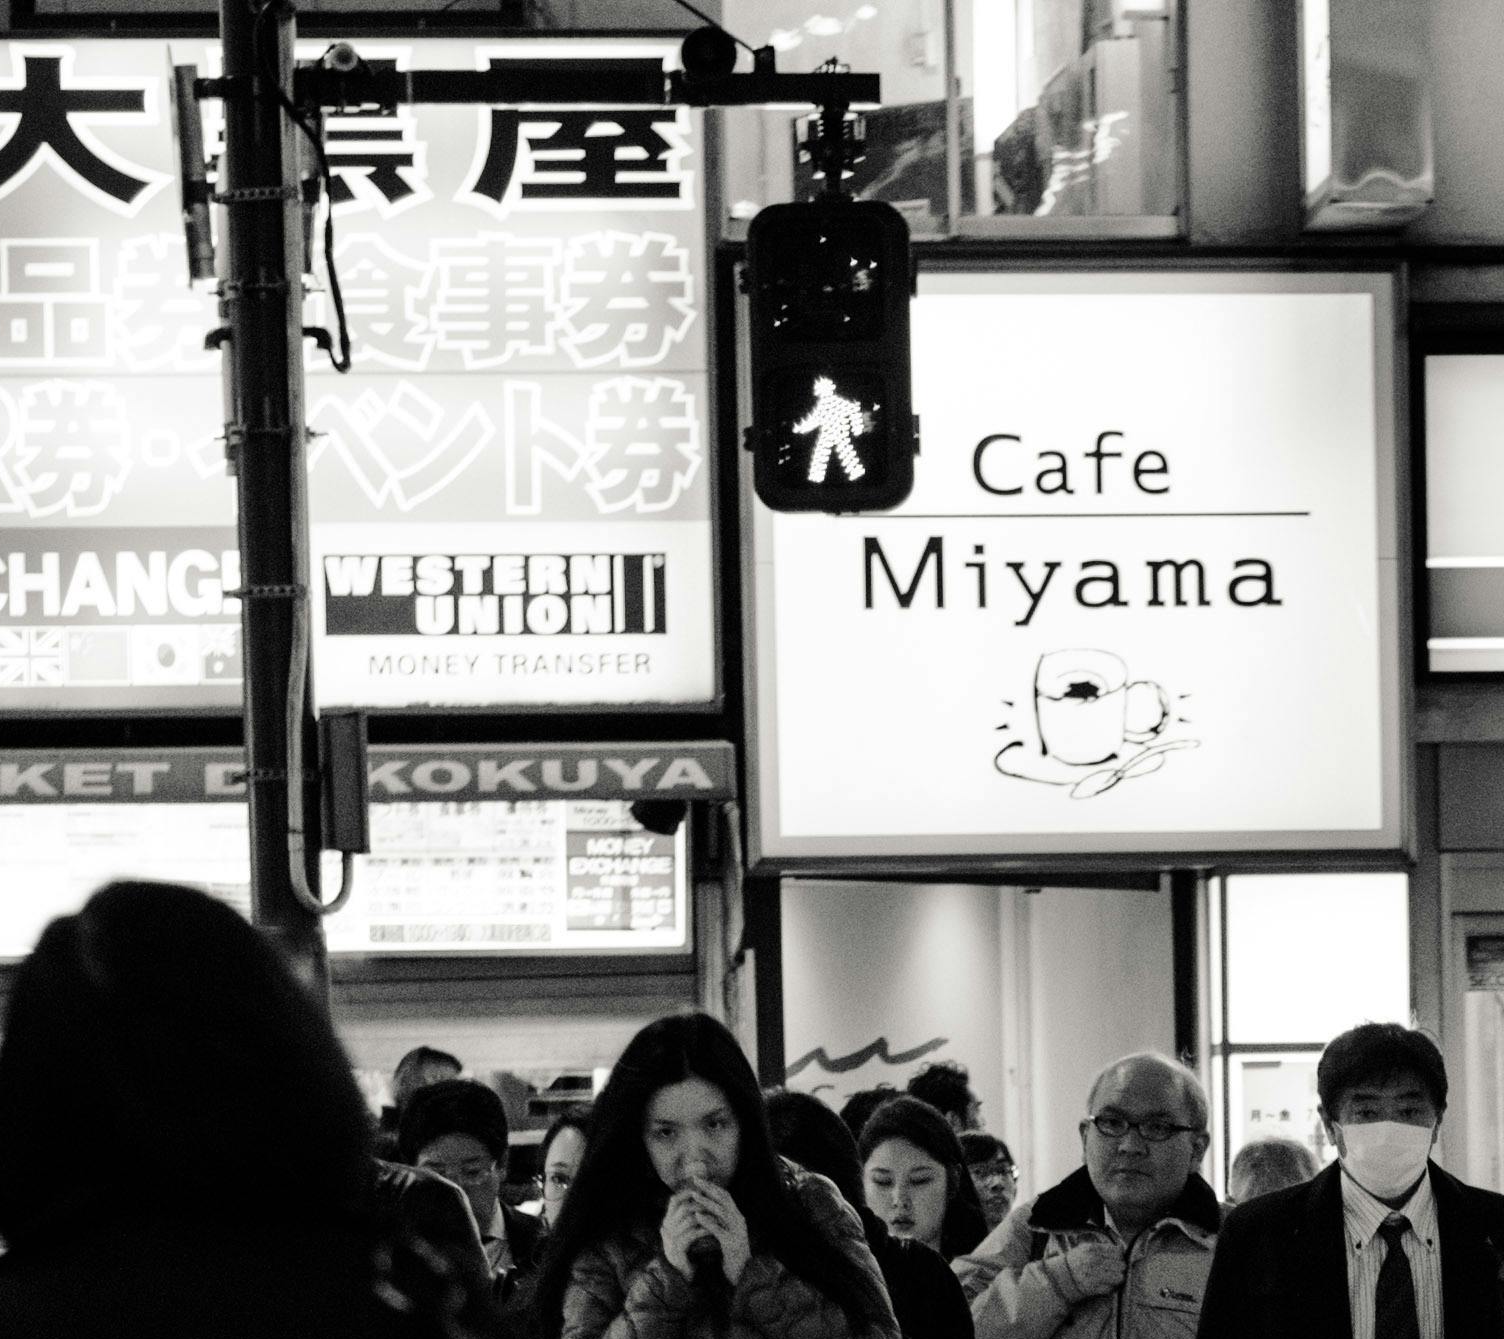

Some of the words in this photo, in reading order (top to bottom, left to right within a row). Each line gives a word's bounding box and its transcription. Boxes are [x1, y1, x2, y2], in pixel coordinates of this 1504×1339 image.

[971, 431, 1171, 496] Cafe
[323, 554, 613, 597] WESTERN
[862, 535, 1285, 627] Miyama
[415, 594, 614, 637] UNION
[368, 653, 479, 676] MONEY
[493, 652, 653, 675] TRANSFER
[204, 757, 714, 797] DKOKUYA
